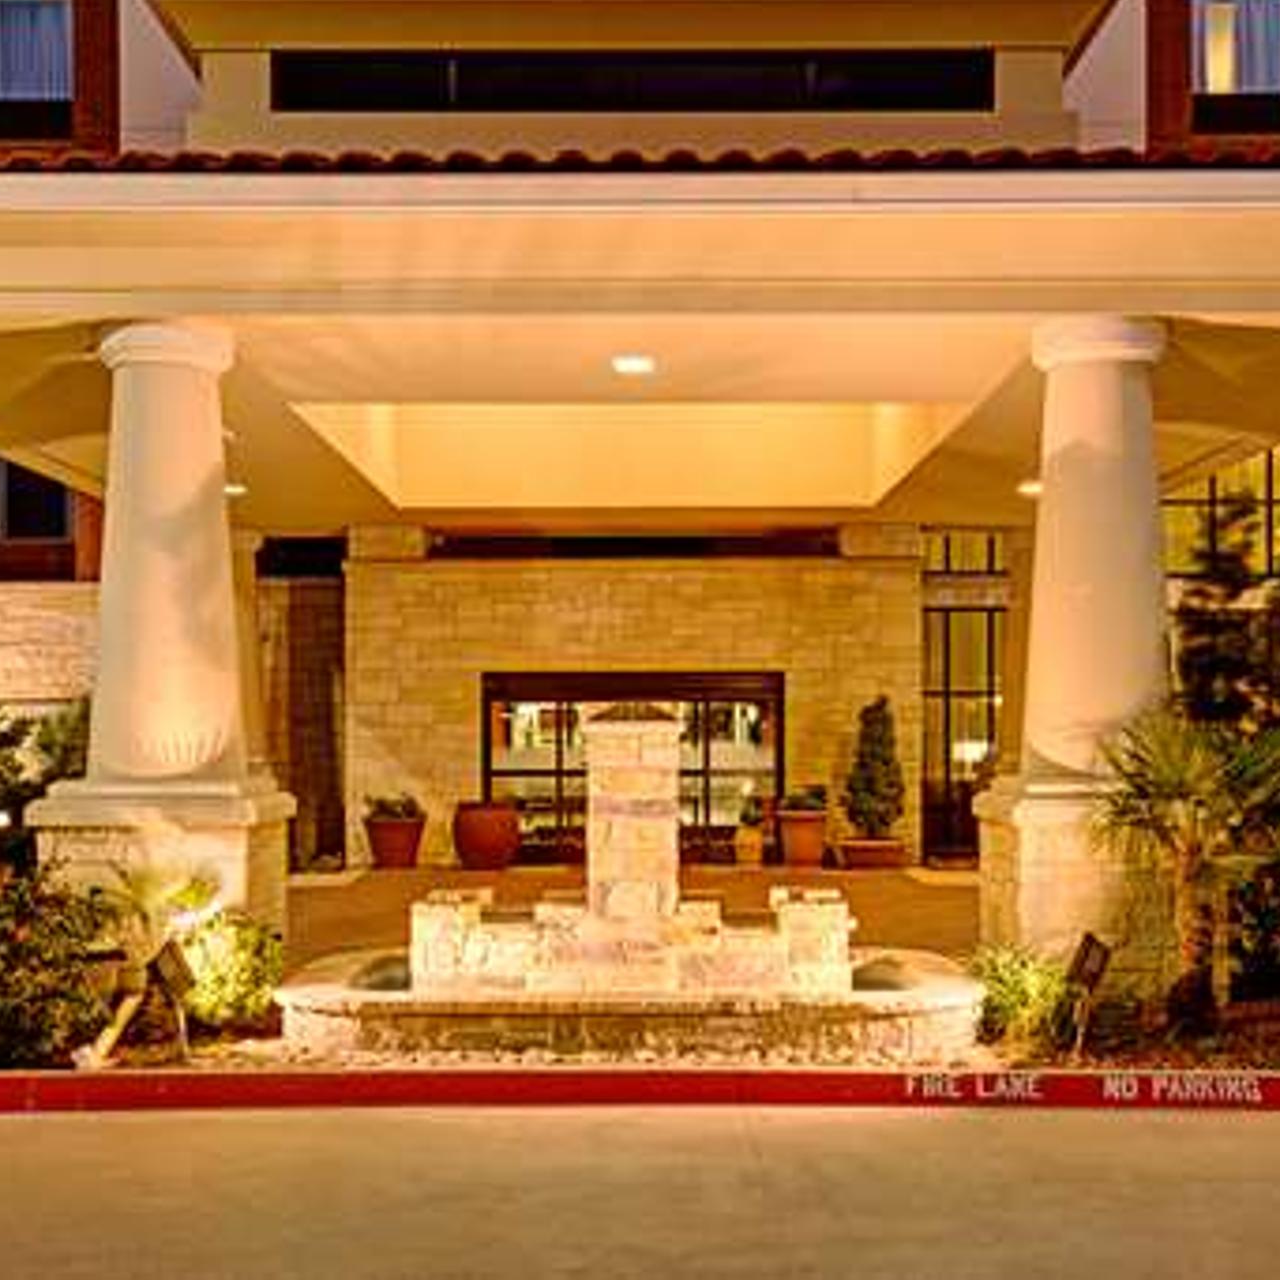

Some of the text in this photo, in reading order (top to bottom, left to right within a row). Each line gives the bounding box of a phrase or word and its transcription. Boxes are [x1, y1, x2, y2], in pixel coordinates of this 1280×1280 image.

[906, 1074, 1262, 1102] FIRE LANE NO PARKING
